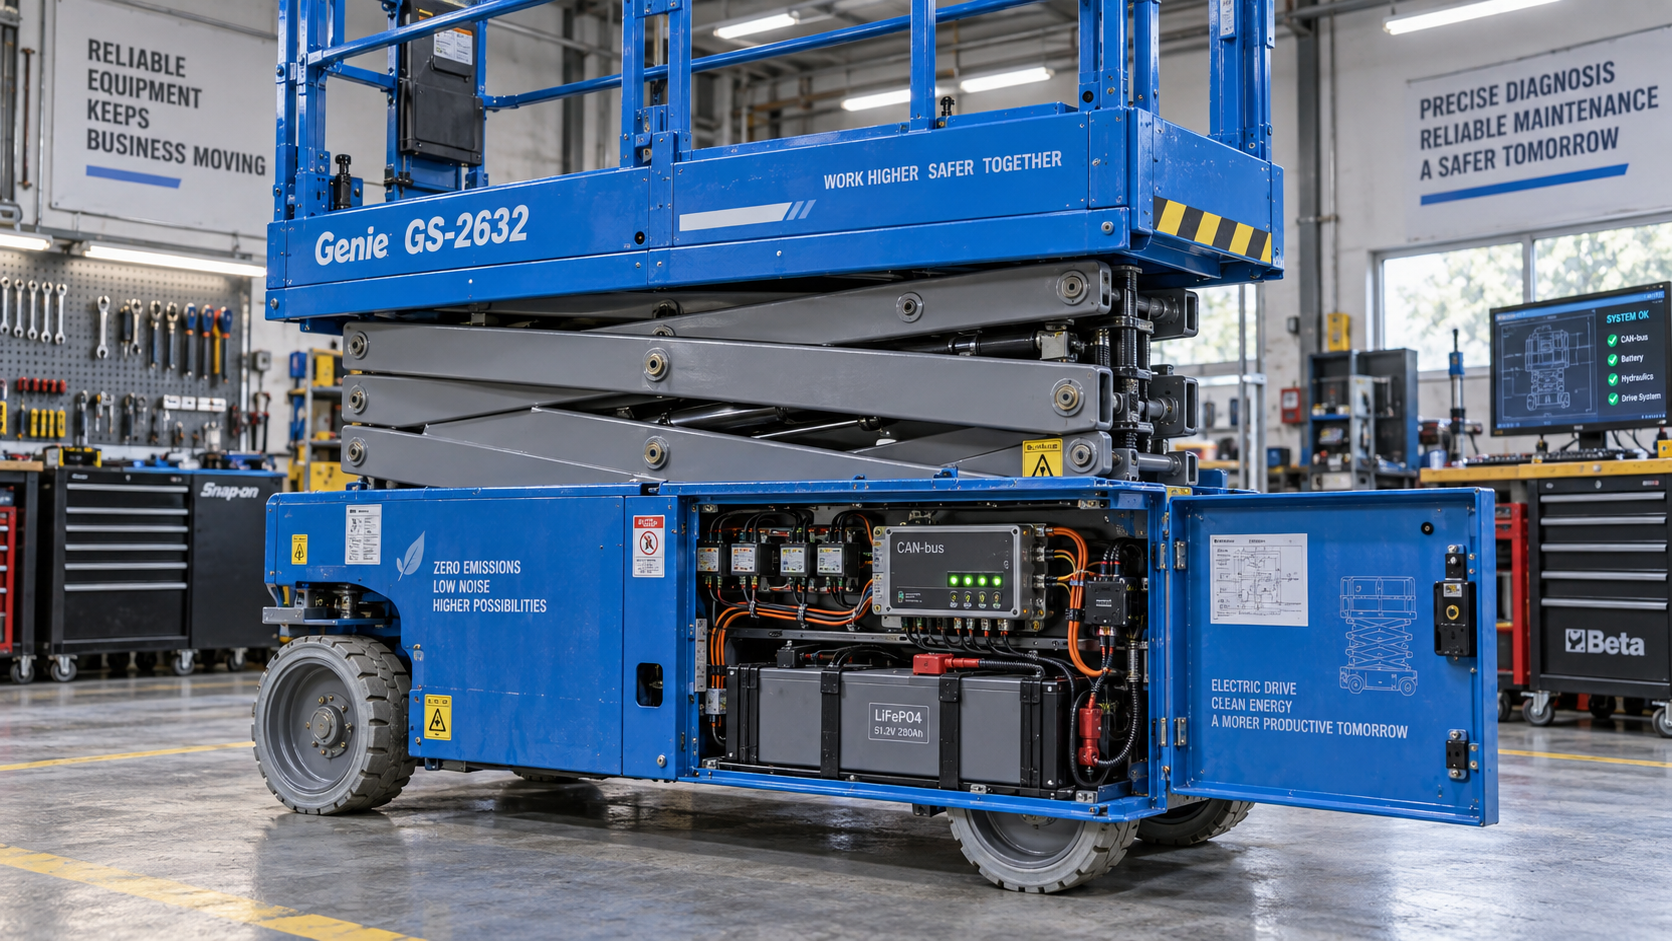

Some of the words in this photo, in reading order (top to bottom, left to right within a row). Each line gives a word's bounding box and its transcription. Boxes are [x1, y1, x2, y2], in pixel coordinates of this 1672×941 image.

[88, 38, 186, 78] RELIABLE
[87, 68, 202, 109] EQUIPMENT
[1420, 84, 1499, 120] PRECISE
[1506, 60, 1615, 103] DIAGNOSIS
[87, 98, 150, 129] KEEPS
[1420, 114, 1507, 151] RELIABLE
[1513, 85, 1659, 134] MAINTENANCE
[87, 128, 186, 164] BUSINESS
[193, 145, 266, 177] MOVING
[1420, 159, 1432, 181] A
[1438, 148, 1496, 178] SAFER
[1502, 126, 1620, 167] TOMORROW
[823, 170, 864, 190] WORK
[867, 165, 919, 186] HIGHER
[928, 159, 974, 179] SAFER
[982, 150, 1062, 174] TOGETHER
[315, 226, 389, 266] Genie
[404, 204, 529, 255] GS-2632
[1606, 311, 1636, 324] SYSTEM
[1638, 310, 1649, 320] OK
[1620, 333, 1648, 344] CAN-bus
[1621, 394, 1638, 402] Drive
[1638, 392, 1661, 402] System
[200, 482, 259, 501] Snap-on
[897, 541, 945, 554] CAN-bus
[433, 561, 460, 575] ZERO
[463, 560, 521, 574] EMISSIONS
[433, 579, 456, 593] LOW
[459, 579, 490, 593] NOISE
[433, 598, 470, 612] HIGHER
[473, 598, 547, 613] POSSIBILITIES
[1587, 629, 1645, 657] Beta
[1211, 678, 1261, 693] ELECTRIC
[1264, 681, 1297, 695] DRIVE
[875, 709, 923, 724] LiFePO4
[1211, 697, 1246, 711] CLEAN
[1249, 699, 1293, 714] ENERGY
[1211, 714, 1219, 727] A
[1222, 715, 1260, 730] MORER
[1263, 717, 1334, 734] PRODUCTIVE
[1336, 721, 1409, 739] TOMORROW
